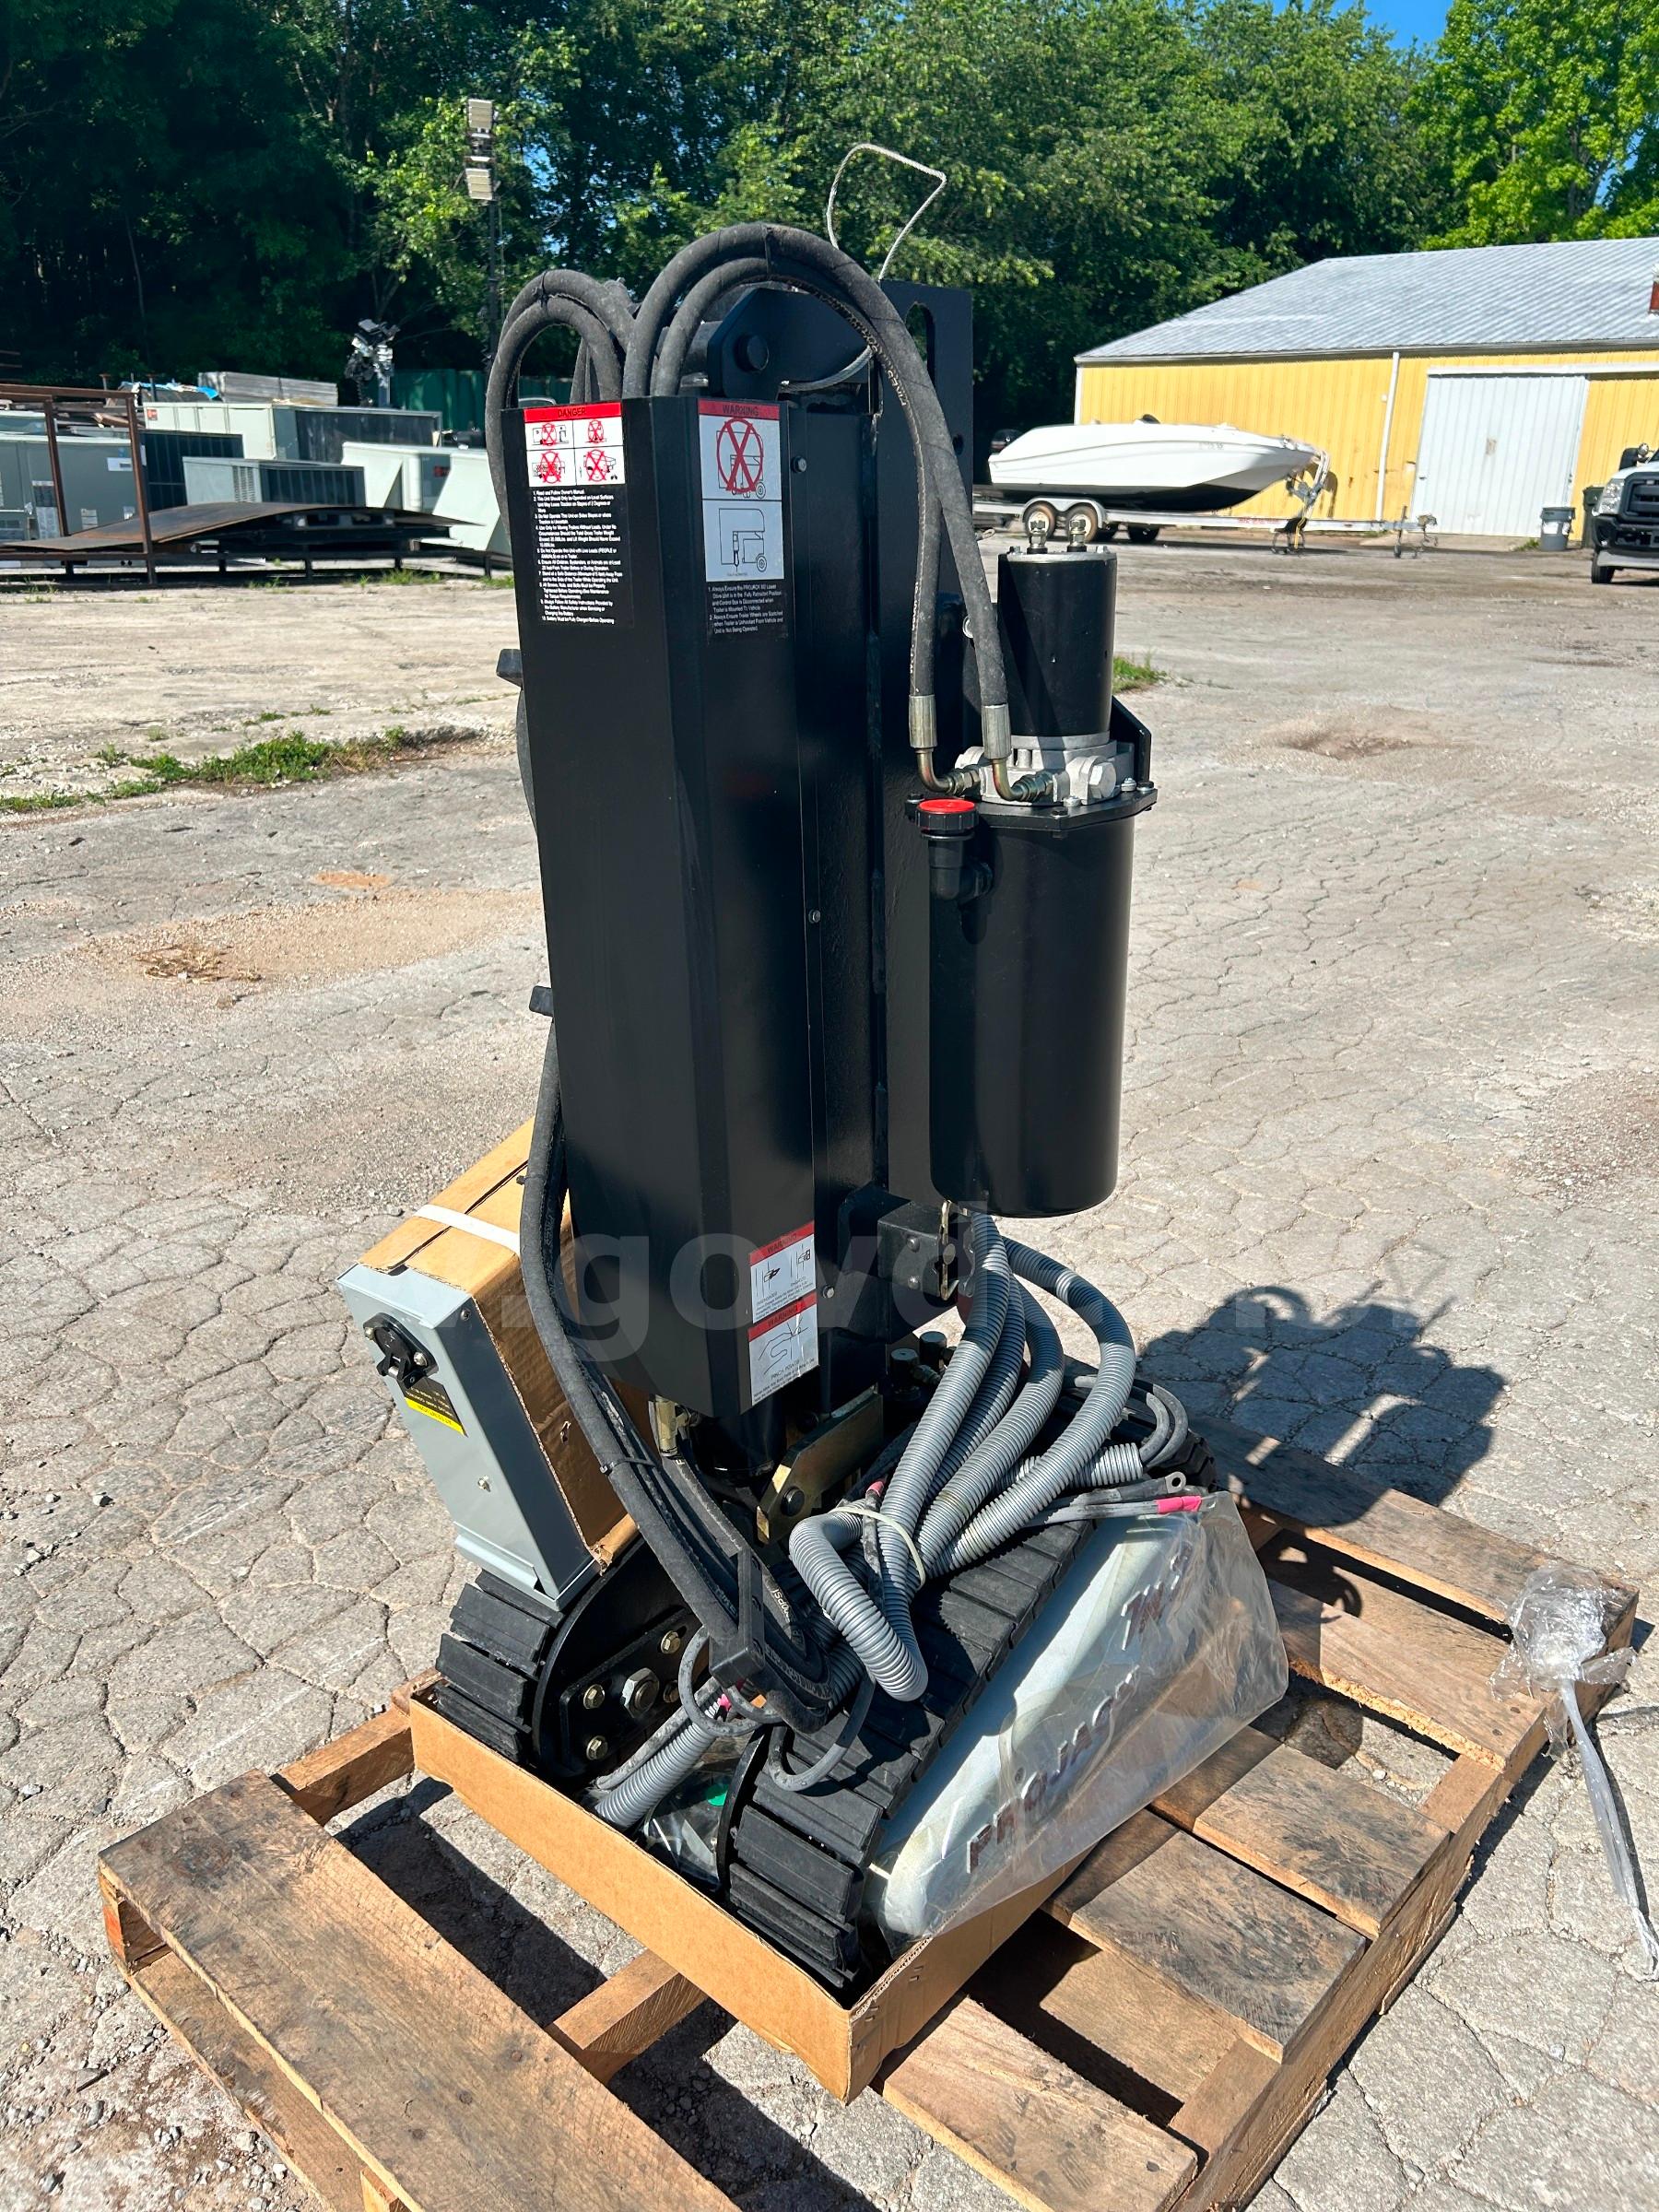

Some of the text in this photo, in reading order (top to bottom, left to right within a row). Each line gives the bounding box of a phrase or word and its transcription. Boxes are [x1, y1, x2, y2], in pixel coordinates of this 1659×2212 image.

[558, 407, 586, 418] DANGER
[723, 405, 759, 417] WARNING
[767, 1232, 797, 1254] WARNING
